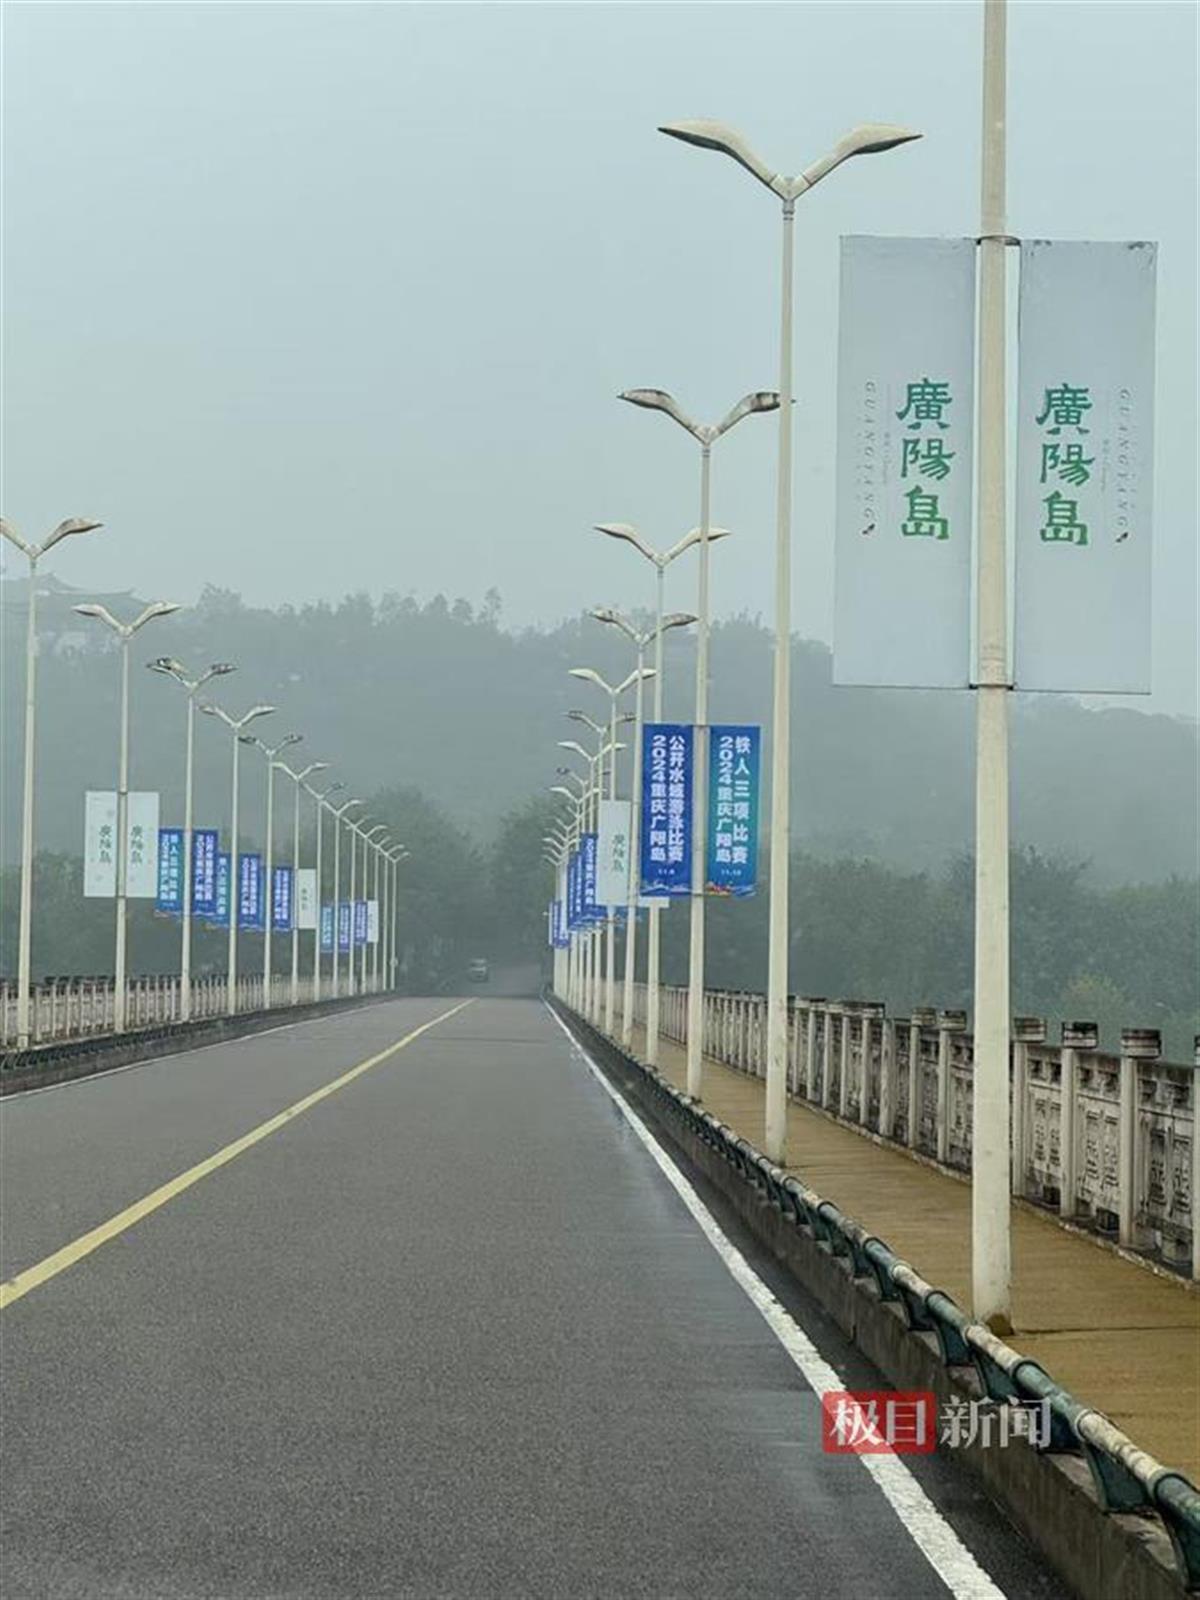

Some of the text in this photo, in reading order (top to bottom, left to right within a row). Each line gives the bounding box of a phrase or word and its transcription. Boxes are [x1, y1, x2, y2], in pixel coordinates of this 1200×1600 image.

[895, 377, 955, 541] 廣陽島
[1035, 382, 1096, 547] 廣陽島
